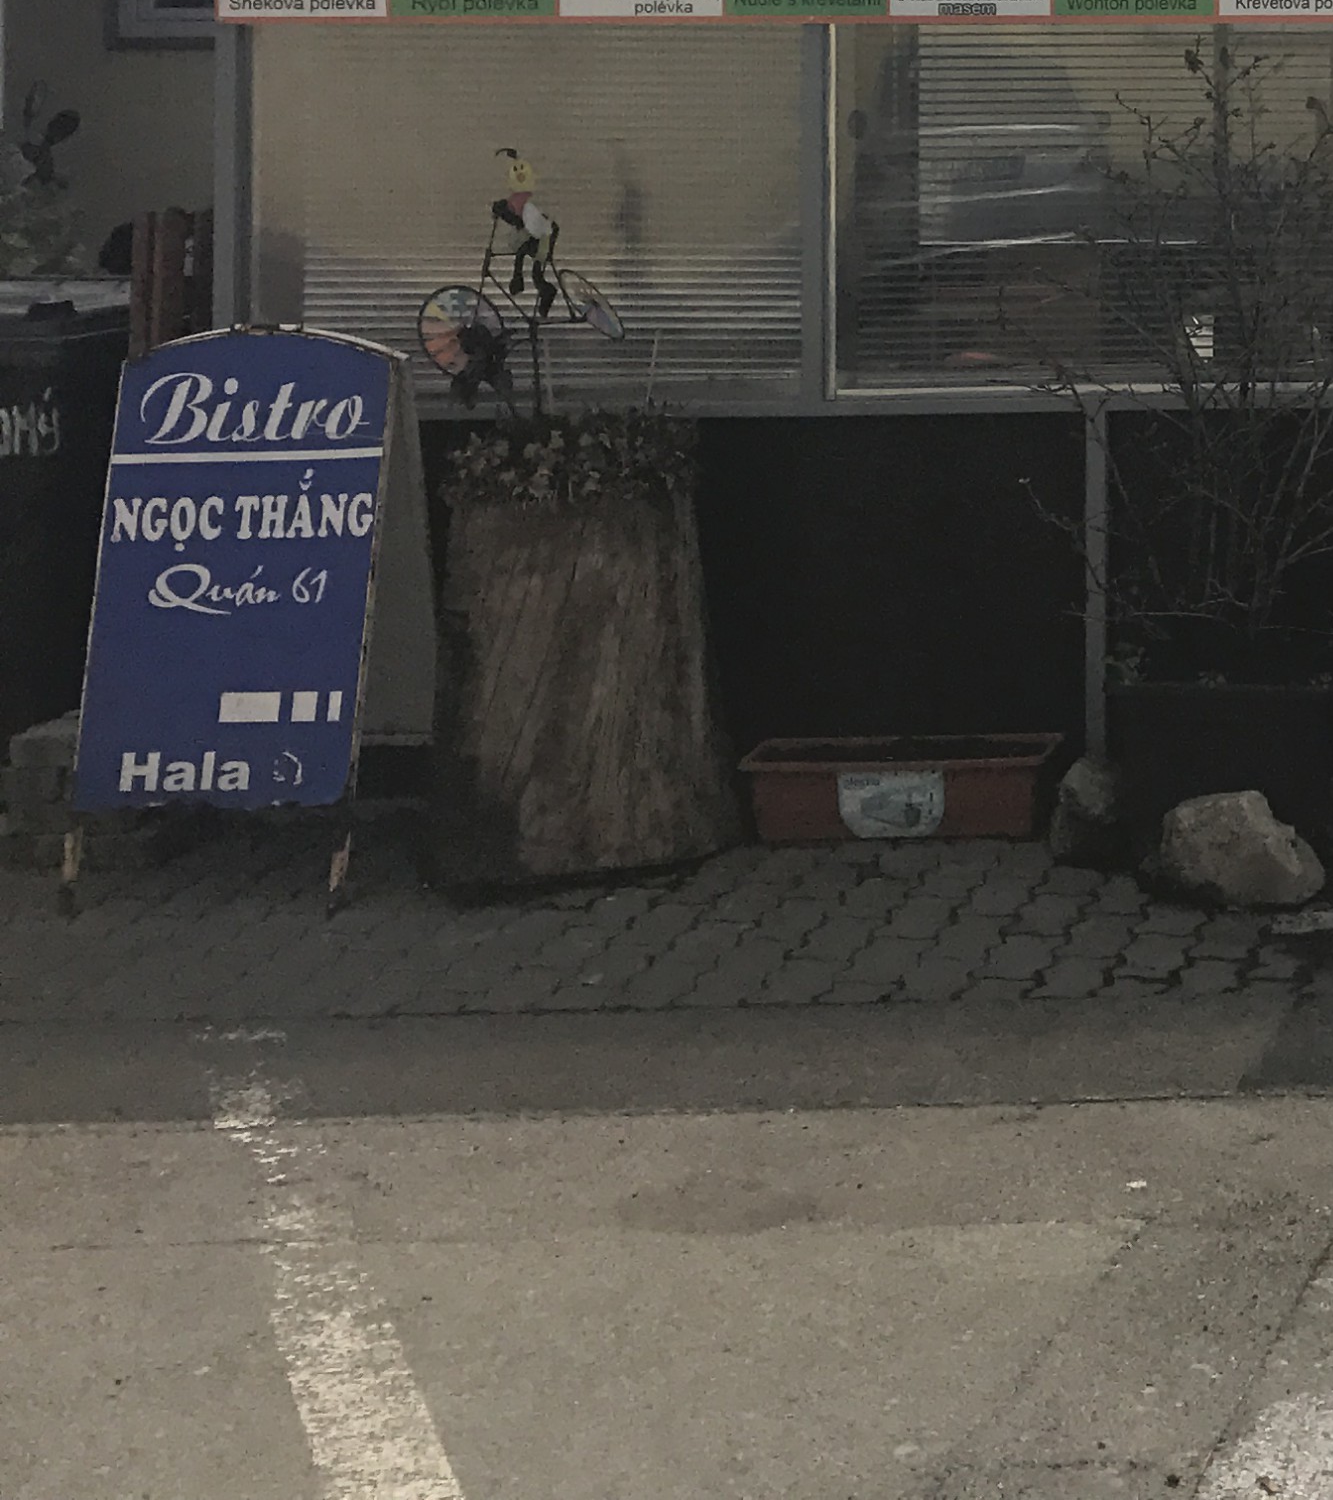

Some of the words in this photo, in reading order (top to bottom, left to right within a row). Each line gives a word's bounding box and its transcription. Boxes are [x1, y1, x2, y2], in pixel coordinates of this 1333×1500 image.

[634, 1, 693, 17] polévka
[938, 2, 997, 16] masem
[141, 372, 371, 445] Bistro
[110, 495, 224, 553] NGỌC
[235, 468, 375, 541] THẮNG
[148, 563, 279, 615] Quán
[291, 566, 328, 606] 61
[118, 751, 249, 793] Hala
